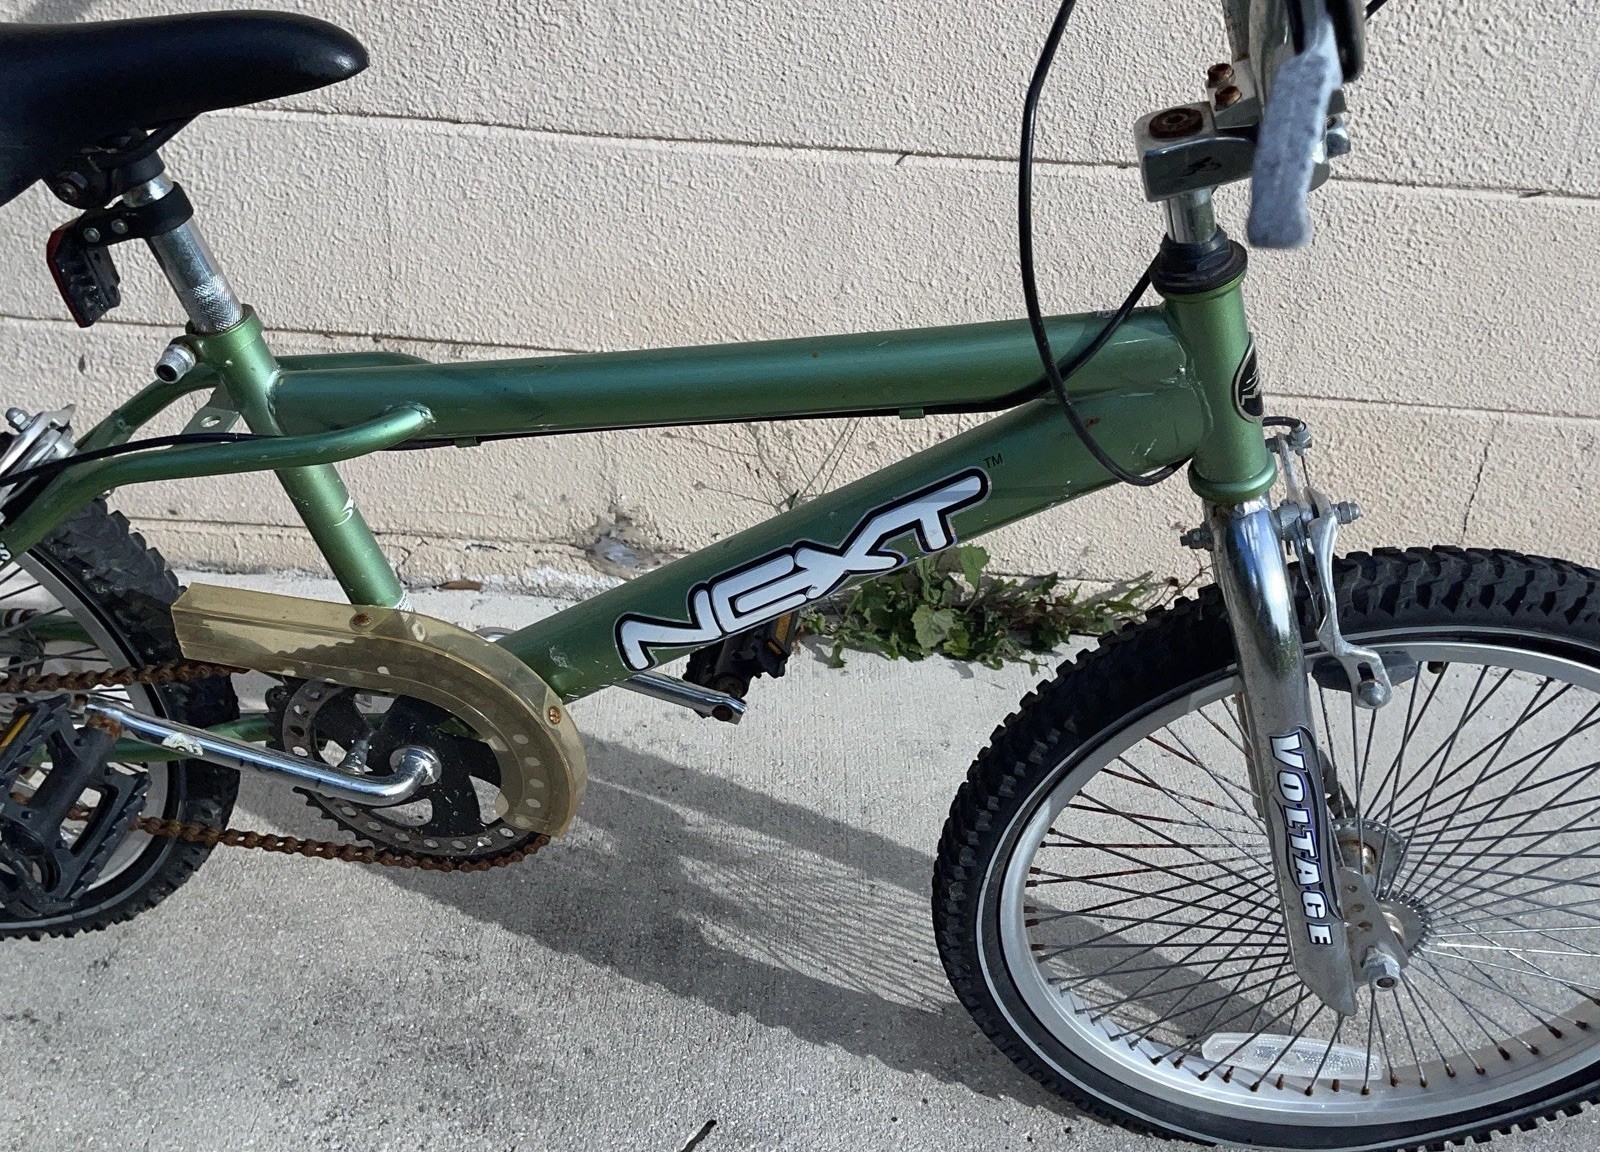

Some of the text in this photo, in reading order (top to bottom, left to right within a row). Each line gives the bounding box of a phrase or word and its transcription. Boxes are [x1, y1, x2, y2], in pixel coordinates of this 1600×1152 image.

[615, 453, 1004, 672] NEXT TM
[1269, 731, 1333, 945] VOLTAGE
